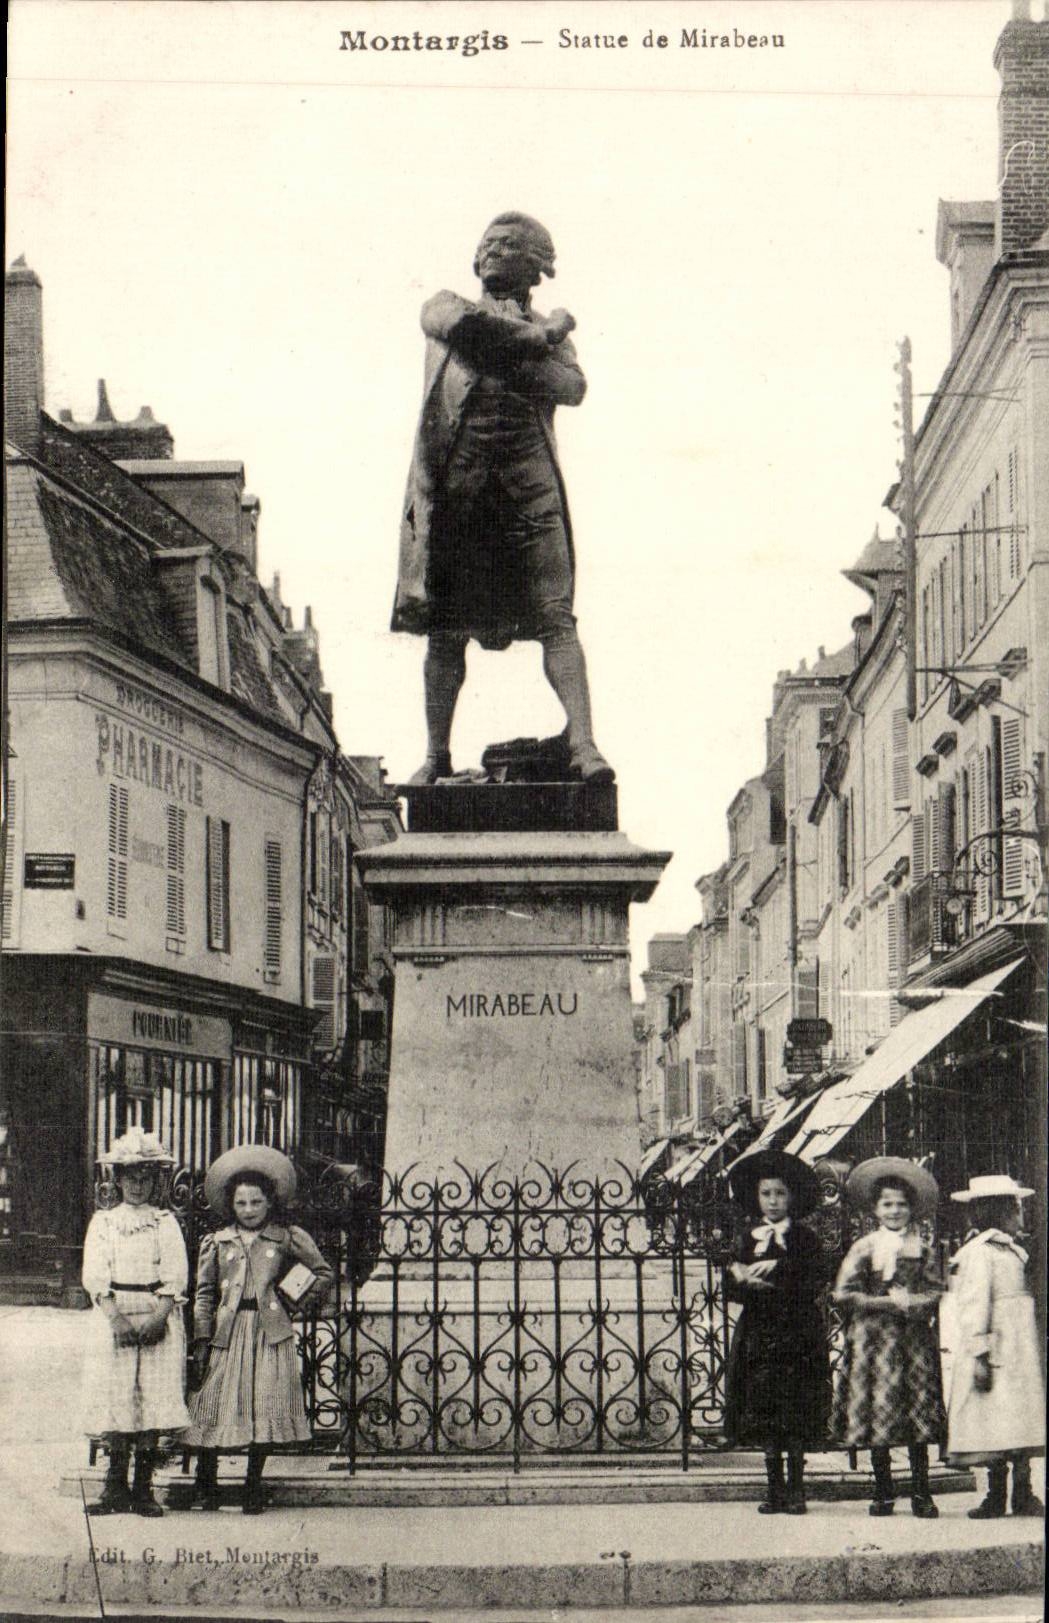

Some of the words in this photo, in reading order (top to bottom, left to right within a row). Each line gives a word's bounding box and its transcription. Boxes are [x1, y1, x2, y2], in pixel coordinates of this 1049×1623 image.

[116, 685, 184, 734] DROGUERIE
[95, 714, 203, 807] PHARMACIE
[446, 992, 578, 1018] MIRABEAU
